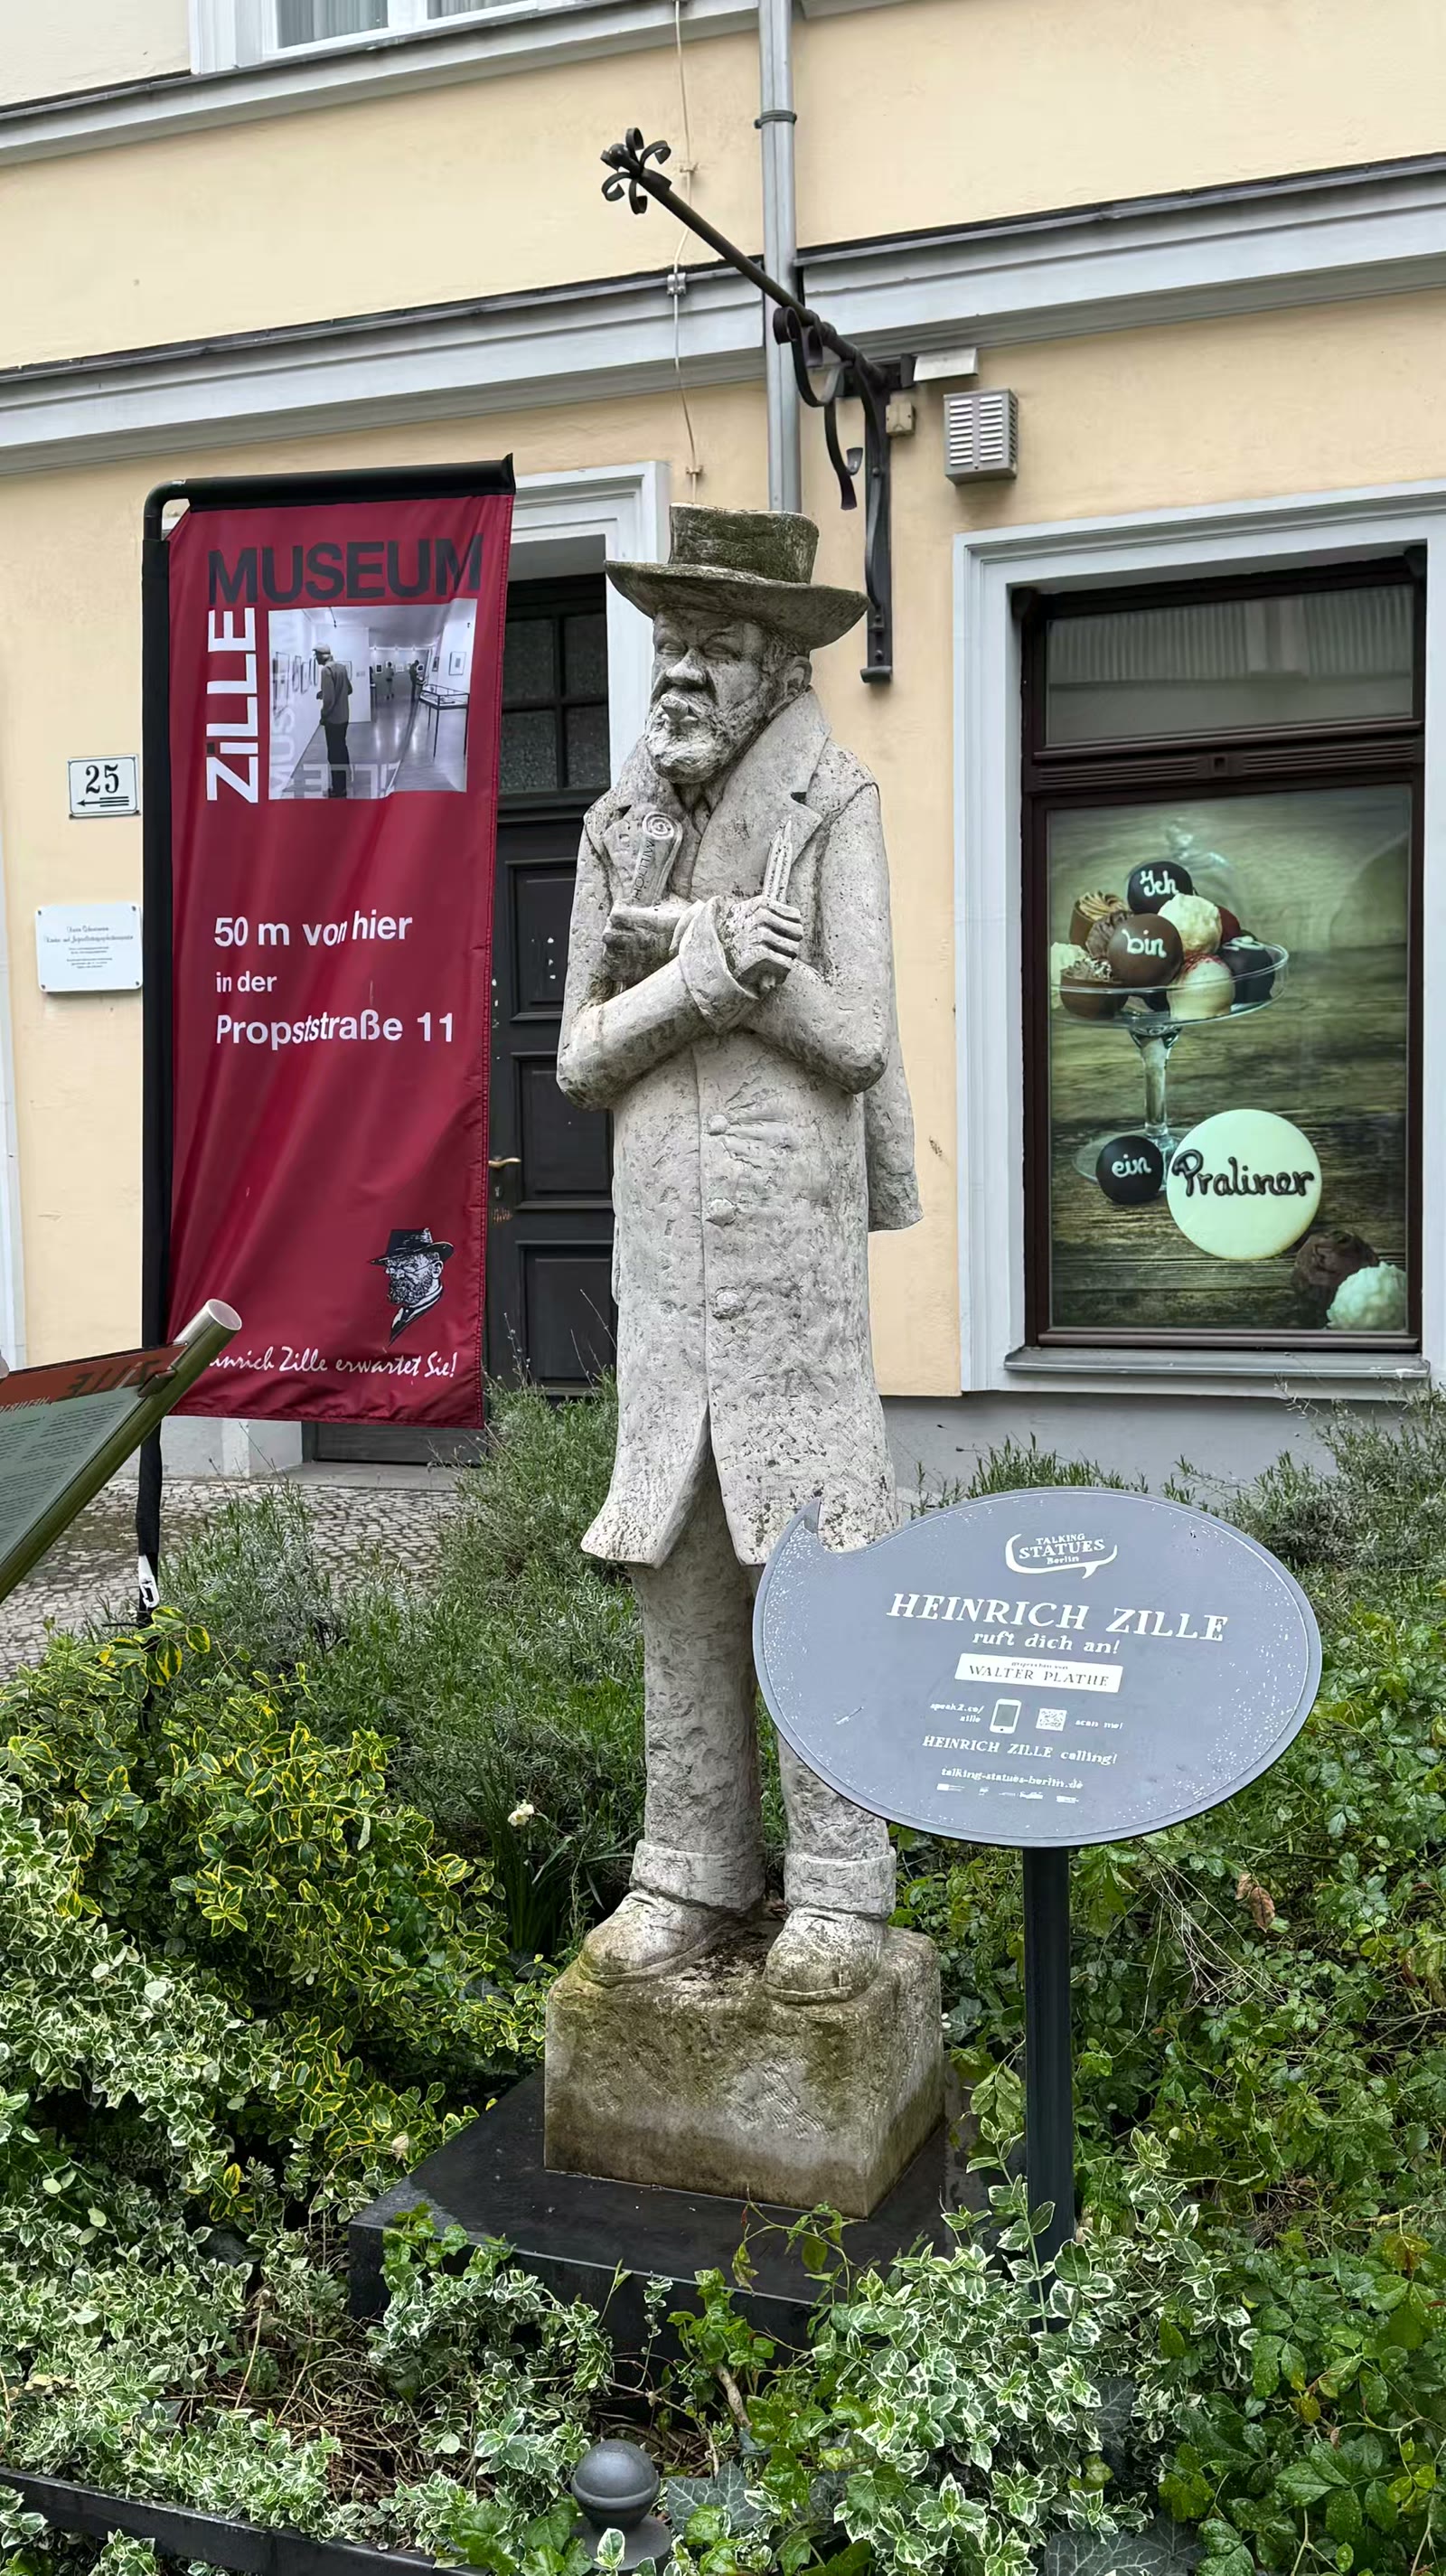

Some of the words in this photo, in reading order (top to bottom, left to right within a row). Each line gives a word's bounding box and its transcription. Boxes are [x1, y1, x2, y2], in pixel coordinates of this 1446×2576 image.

[208, 533, 484, 605] MUSEUM
[85, 763, 120, 794] 25
[214, 917, 249, 947] 50
[258, 922, 290, 946] m
[302, 919, 348, 946] von
[352, 909, 413, 940] hier
[1125, 928, 1167, 959] bin
[216, 971, 232, 992] in
[237, 971, 277, 992] der
[216, 1009, 404, 1051] Propststraße
[417, 1011, 454, 1042] 11
[1111, 1151, 1152, 1176] ein
[1172, 1148, 1316, 1198] Praliner
[209, 1346, 275, 1371] inrich
[278, 1346, 328, 1372] Zille
[335, 1355, 422, 1377] erwartet
[424, 1350, 458, 1378] Sie!
[1019, 1538, 1106, 1559] STATUES
[1035, 1533, 1085, 1546] TALKING
[1047, 1556, 1080, 1565] Berlin
[886, 1593, 1090, 1630] HEINRICH
[1105, 1607, 1229, 1642] ZILLE
[972, 1630, 1015, 1646] ruft
[1024, 1632, 1074, 1651] dich
[1083, 1640, 1122, 1655] an!
[969, 1664, 1034, 1680] WALTER
[1043, 1670, 1110, 1688] PLATHE
[1075, 1718, 1099, 1727] scan
[922, 1735, 1000, 1753] HEINRICH
[1007, 1743, 1054, 1758] ZILLE
[1060, 1749, 1119, 1766] calling!
[941, 1766, 1084, 1791] talking-statues-berlin.de
